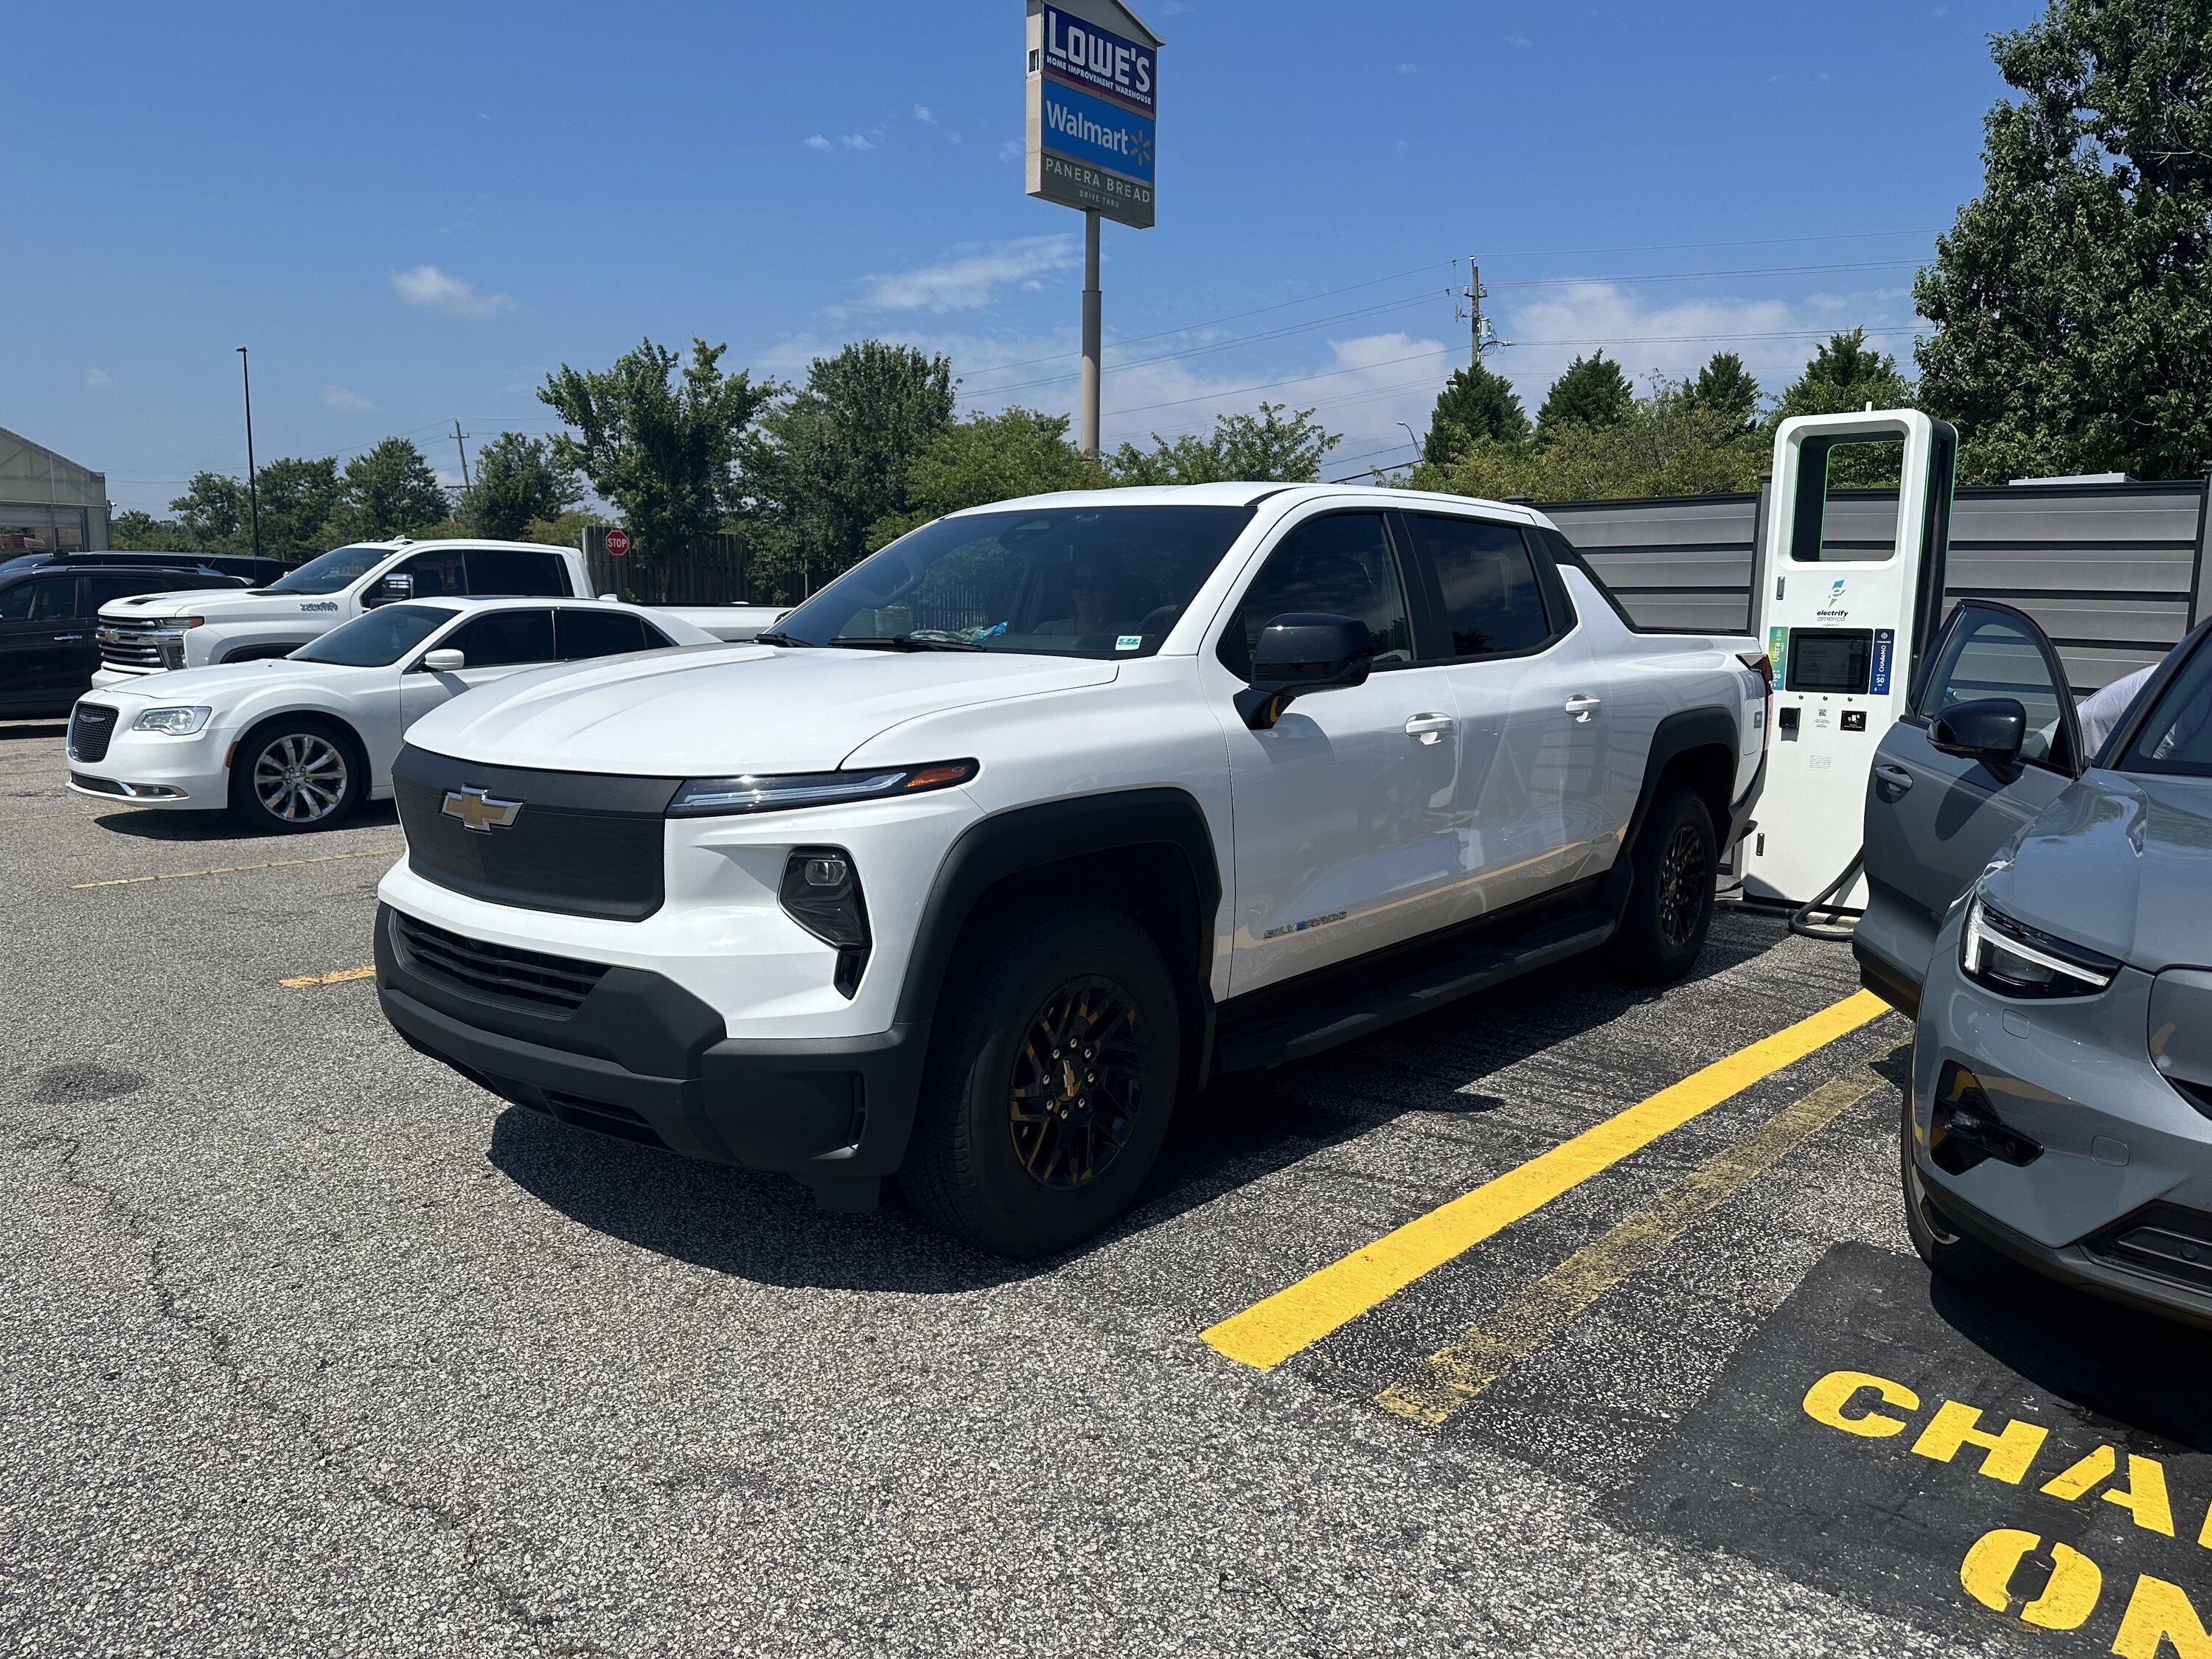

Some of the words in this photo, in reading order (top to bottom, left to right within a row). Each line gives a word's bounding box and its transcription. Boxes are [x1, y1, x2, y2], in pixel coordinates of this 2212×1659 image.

[1048, 10, 1150, 93] LOWE'S
[1046, 55, 1067, 70] HOME
[1068, 64, 1114, 89] IMPROVEMENT
[1115, 83, 1152, 105] WAREHOUSE
[1046, 100, 1129, 156] Walmart
[1046, 157, 1100, 187] PANERA
[1107, 177, 1150, 203] BREAD
[1079, 189, 1099, 202] DRIVE
[1102, 196, 1119, 208] THRU
[608, 538, 627, 548] STOP
[1772, 642, 1781, 662] Ultra
[1801, 1369, 2212, 1550] CHA
